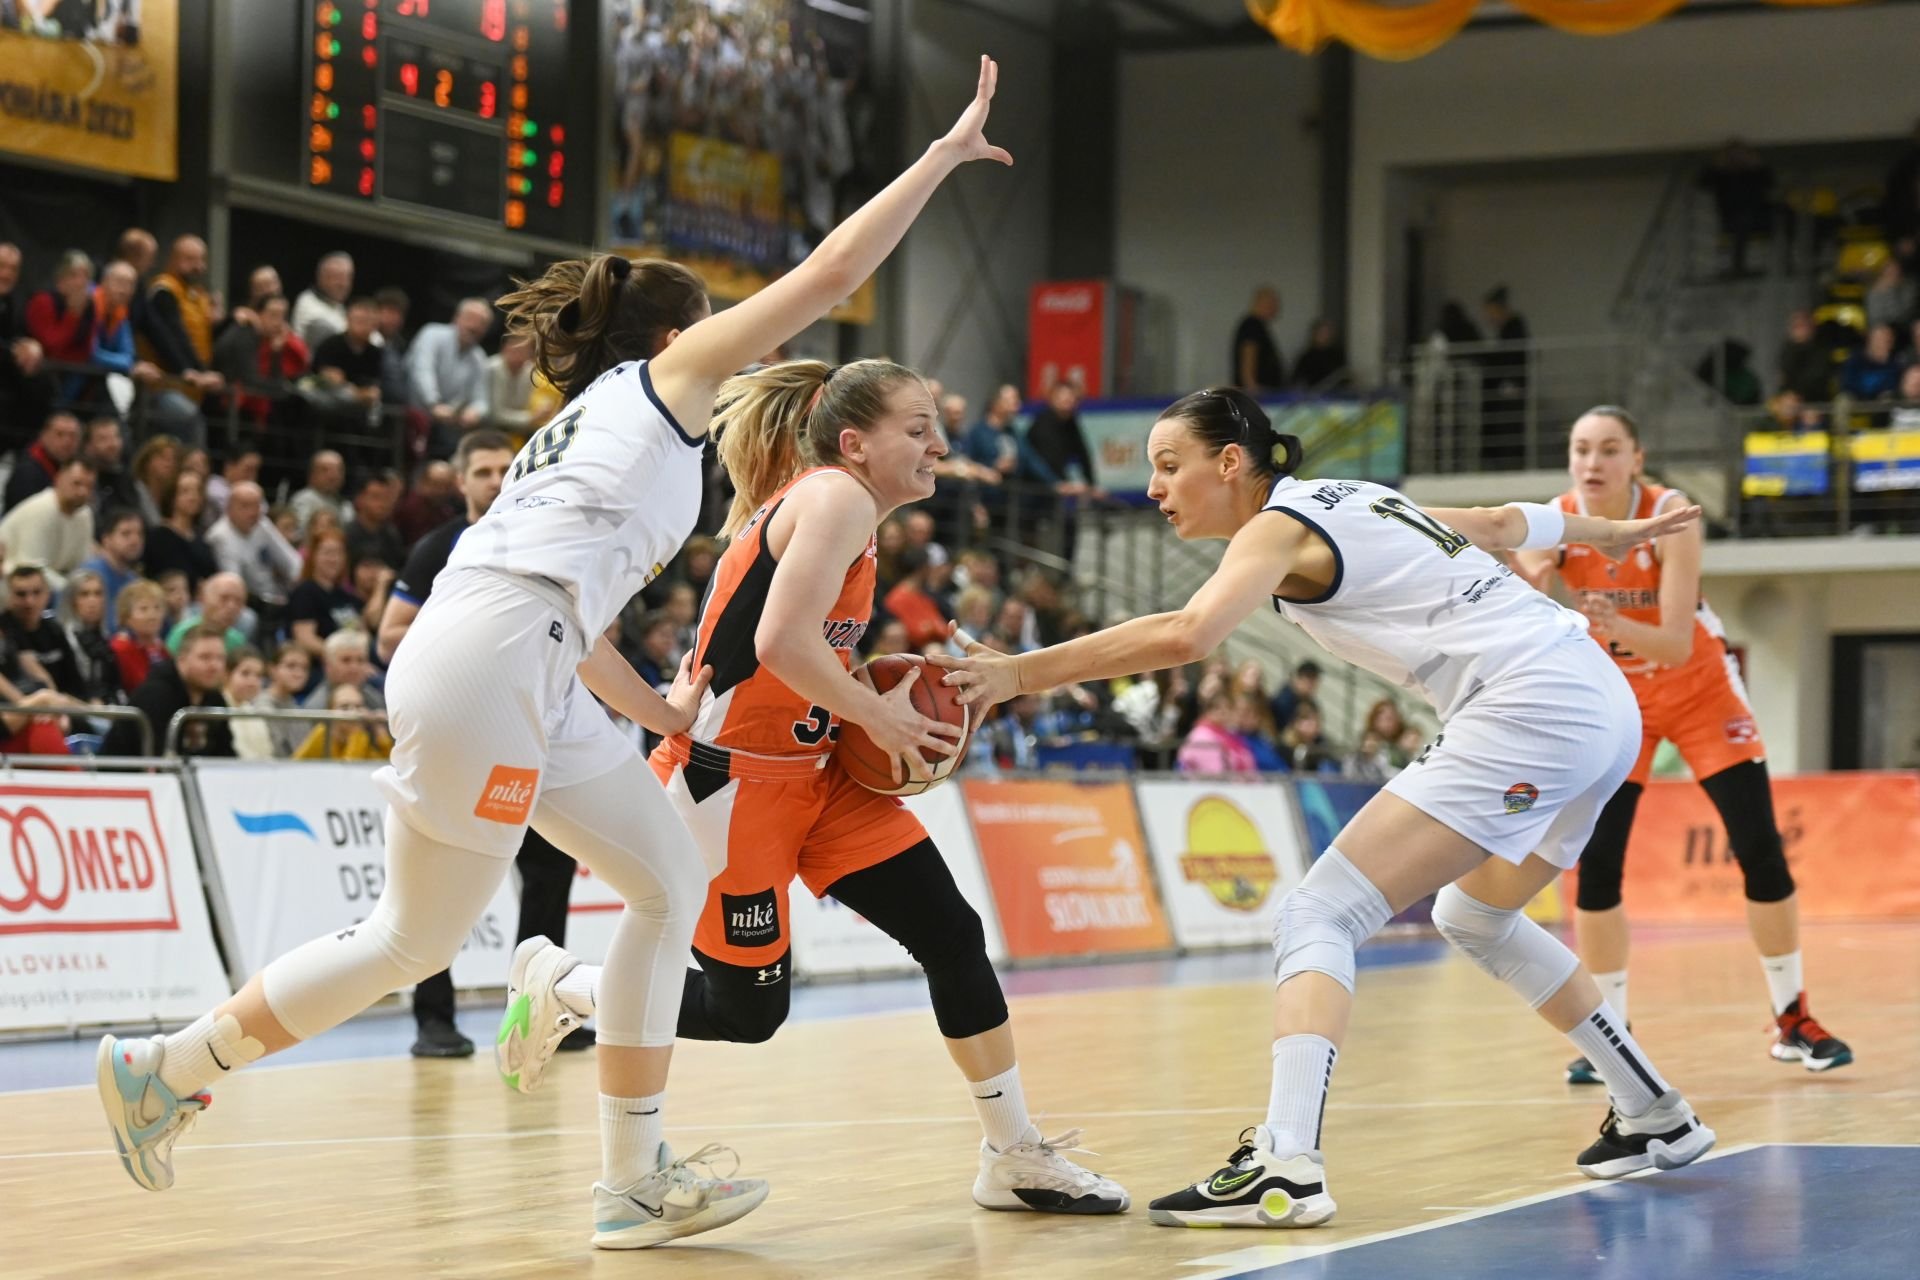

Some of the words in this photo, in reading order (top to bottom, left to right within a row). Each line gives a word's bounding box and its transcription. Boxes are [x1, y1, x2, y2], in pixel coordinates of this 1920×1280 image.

[489, 780, 532, 804] niké
[731, 902, 774, 928] niké
[0, 953, 109, 976] LOVAKIA
